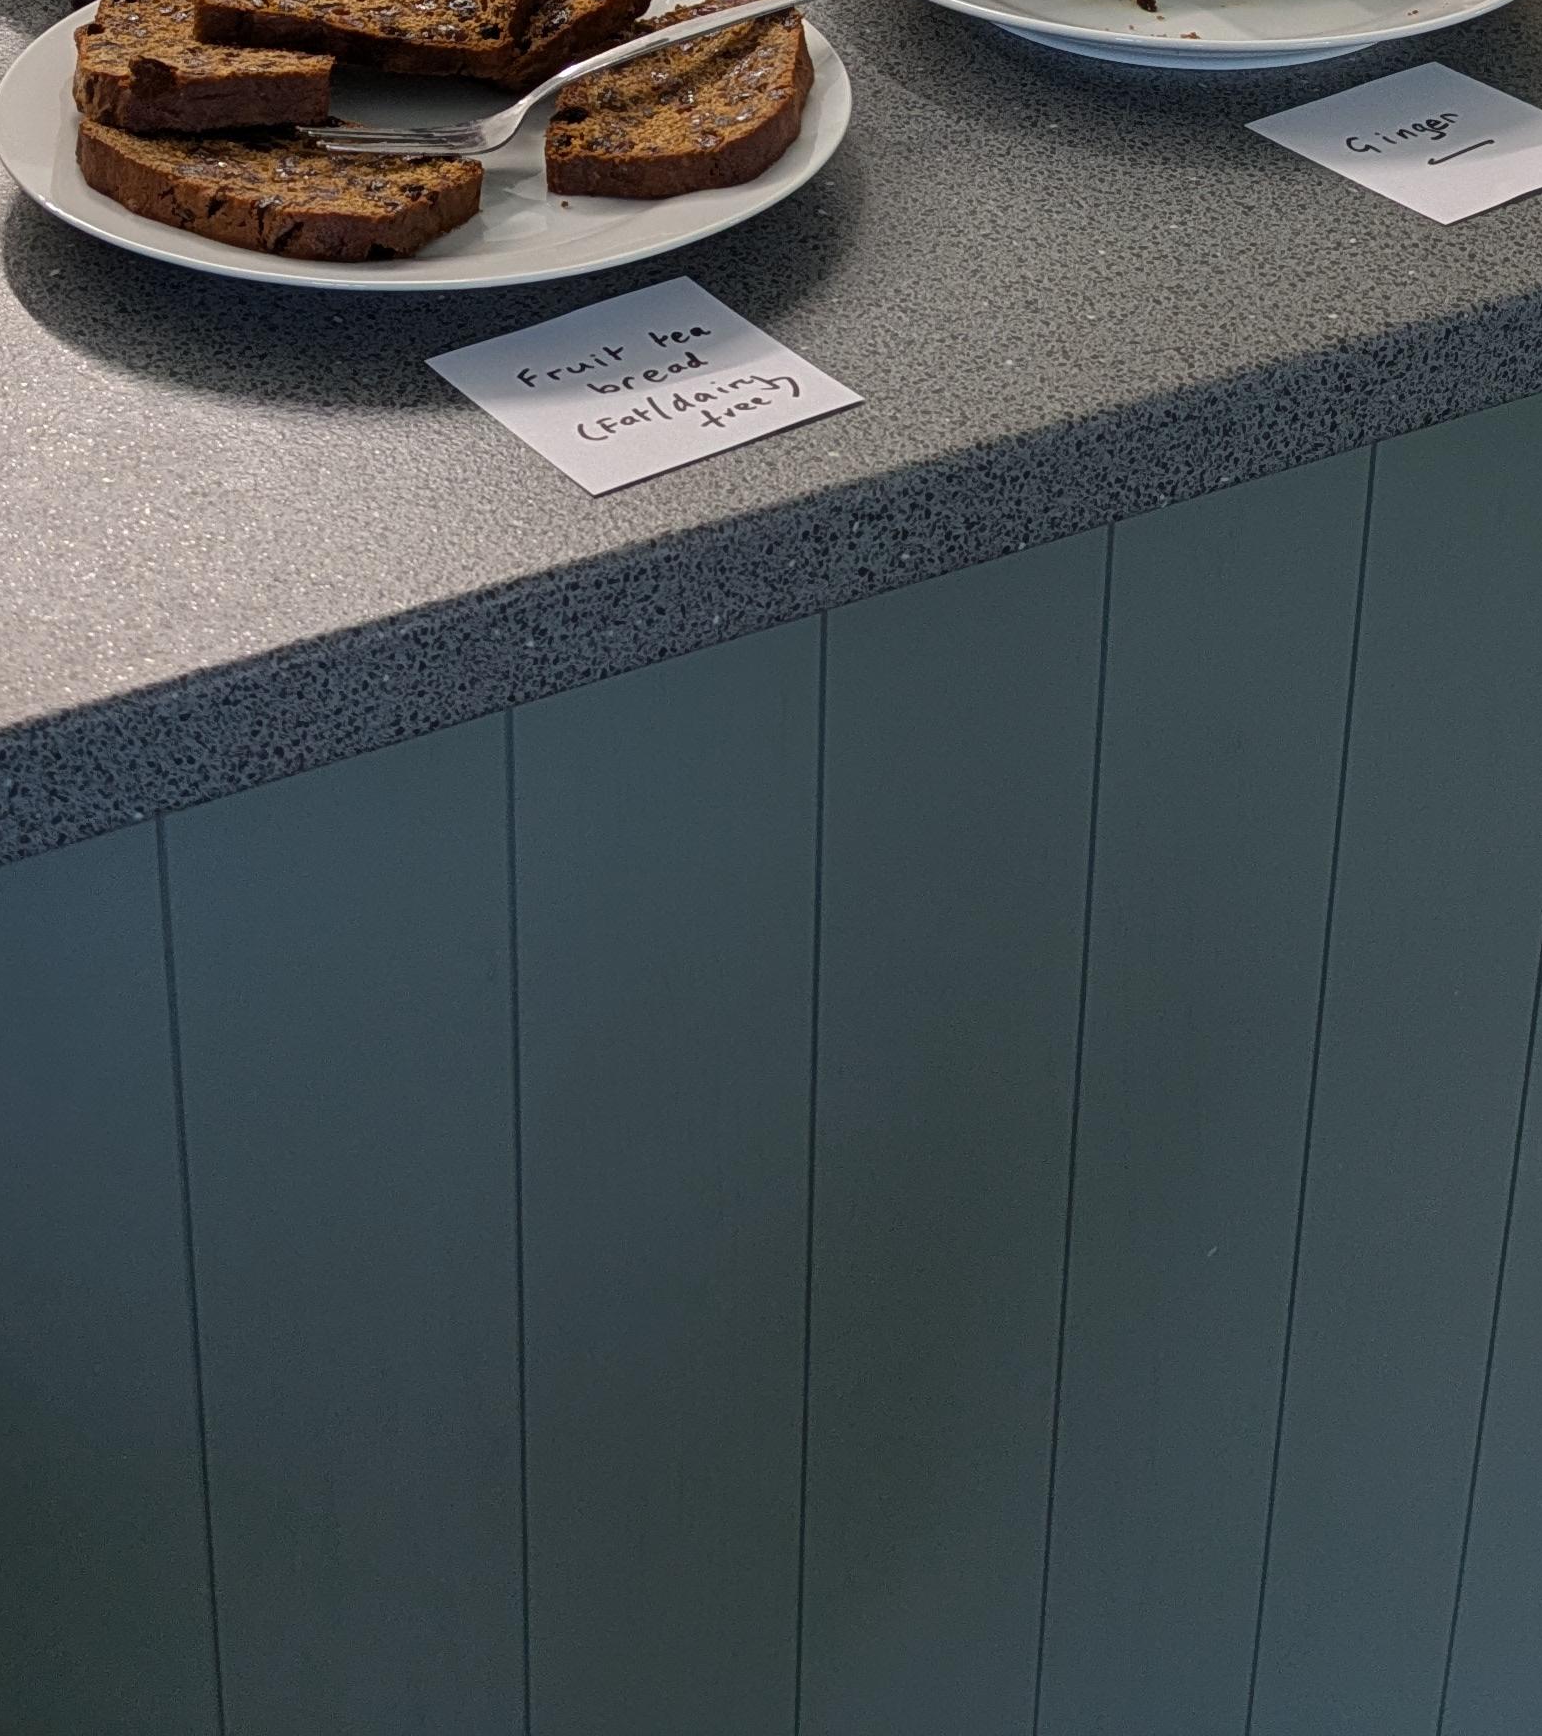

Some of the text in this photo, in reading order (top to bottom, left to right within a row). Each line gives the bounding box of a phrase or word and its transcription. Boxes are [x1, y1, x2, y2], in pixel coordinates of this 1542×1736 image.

[1345, 112, 1459, 153] Ginger
[517, 326, 712, 388] Fruit tea
[586, 351, 709, 395] bread
